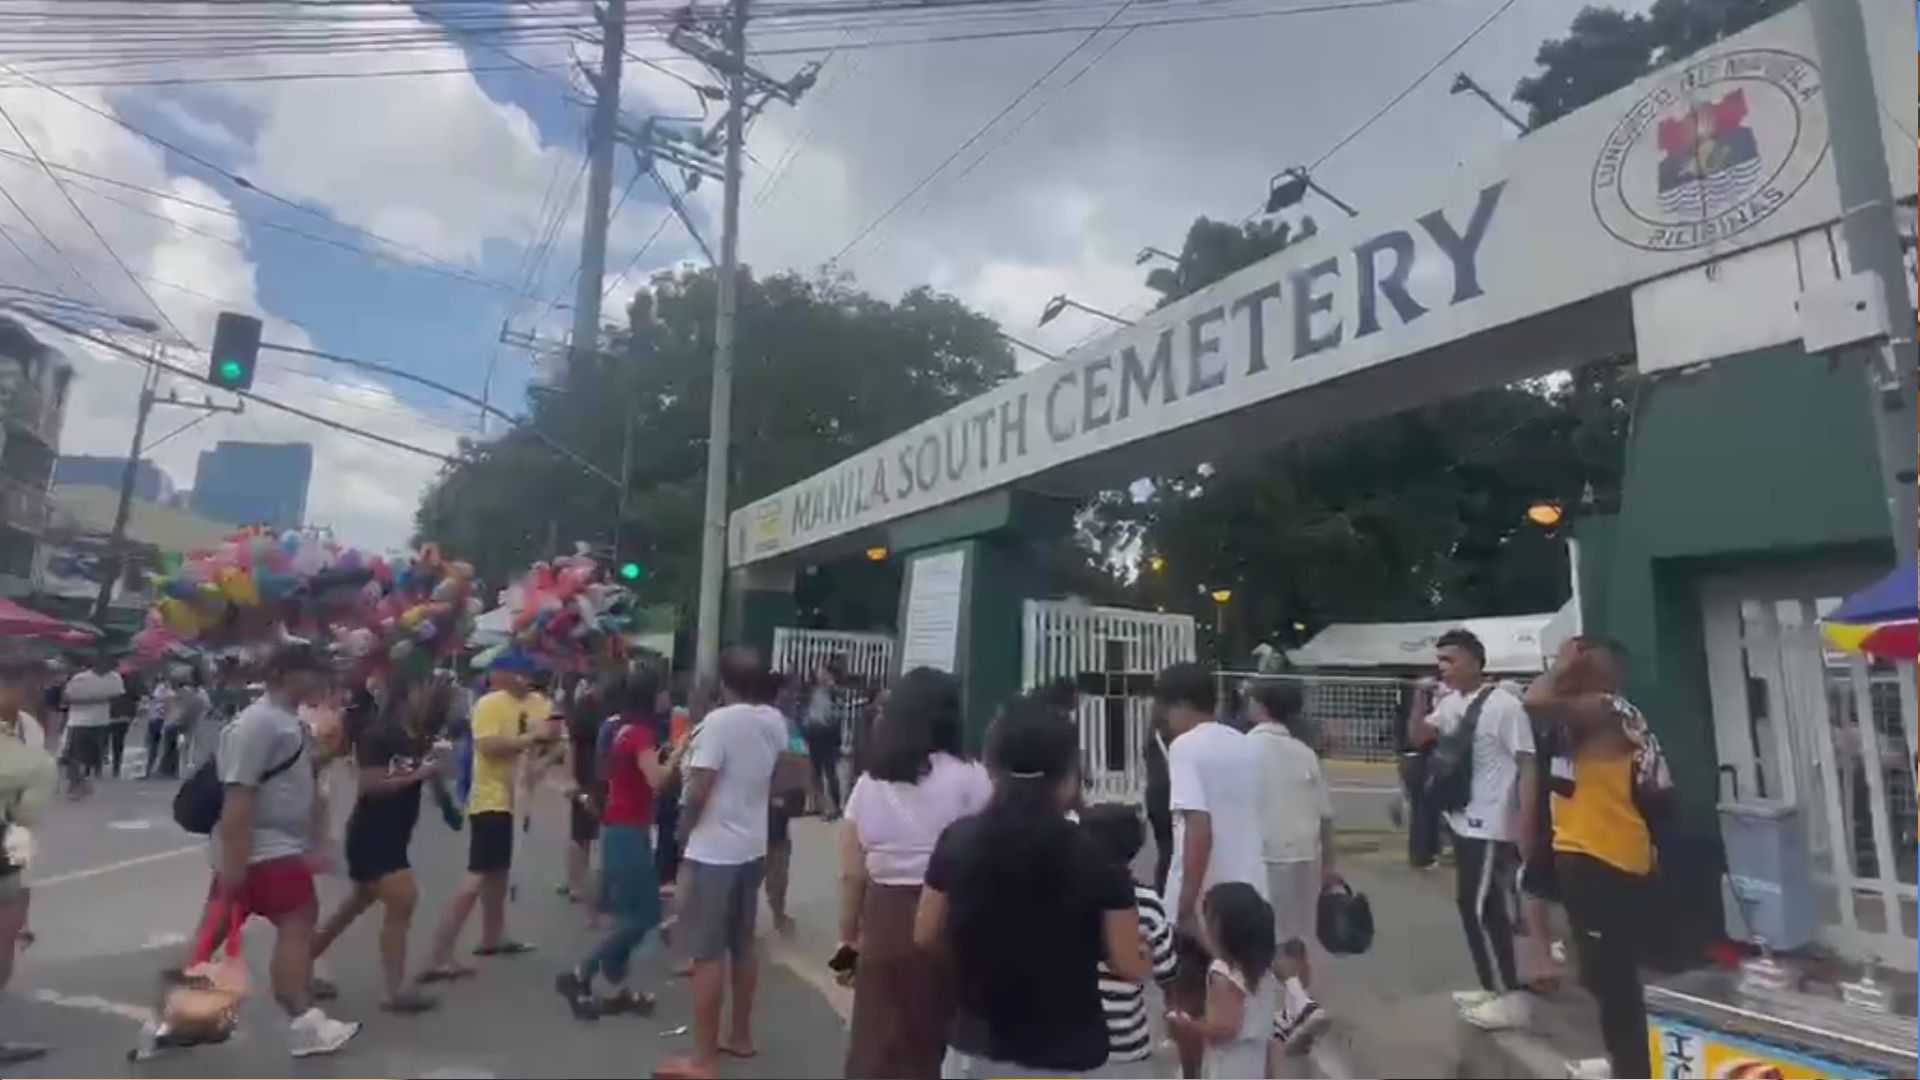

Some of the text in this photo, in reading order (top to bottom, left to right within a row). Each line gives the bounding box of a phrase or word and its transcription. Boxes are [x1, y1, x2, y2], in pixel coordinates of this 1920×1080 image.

[792, 458, 890, 536] MANILA
[897, 393, 1028, 499] SOUTH
[1045, 178, 1509, 443] CEMETERY
